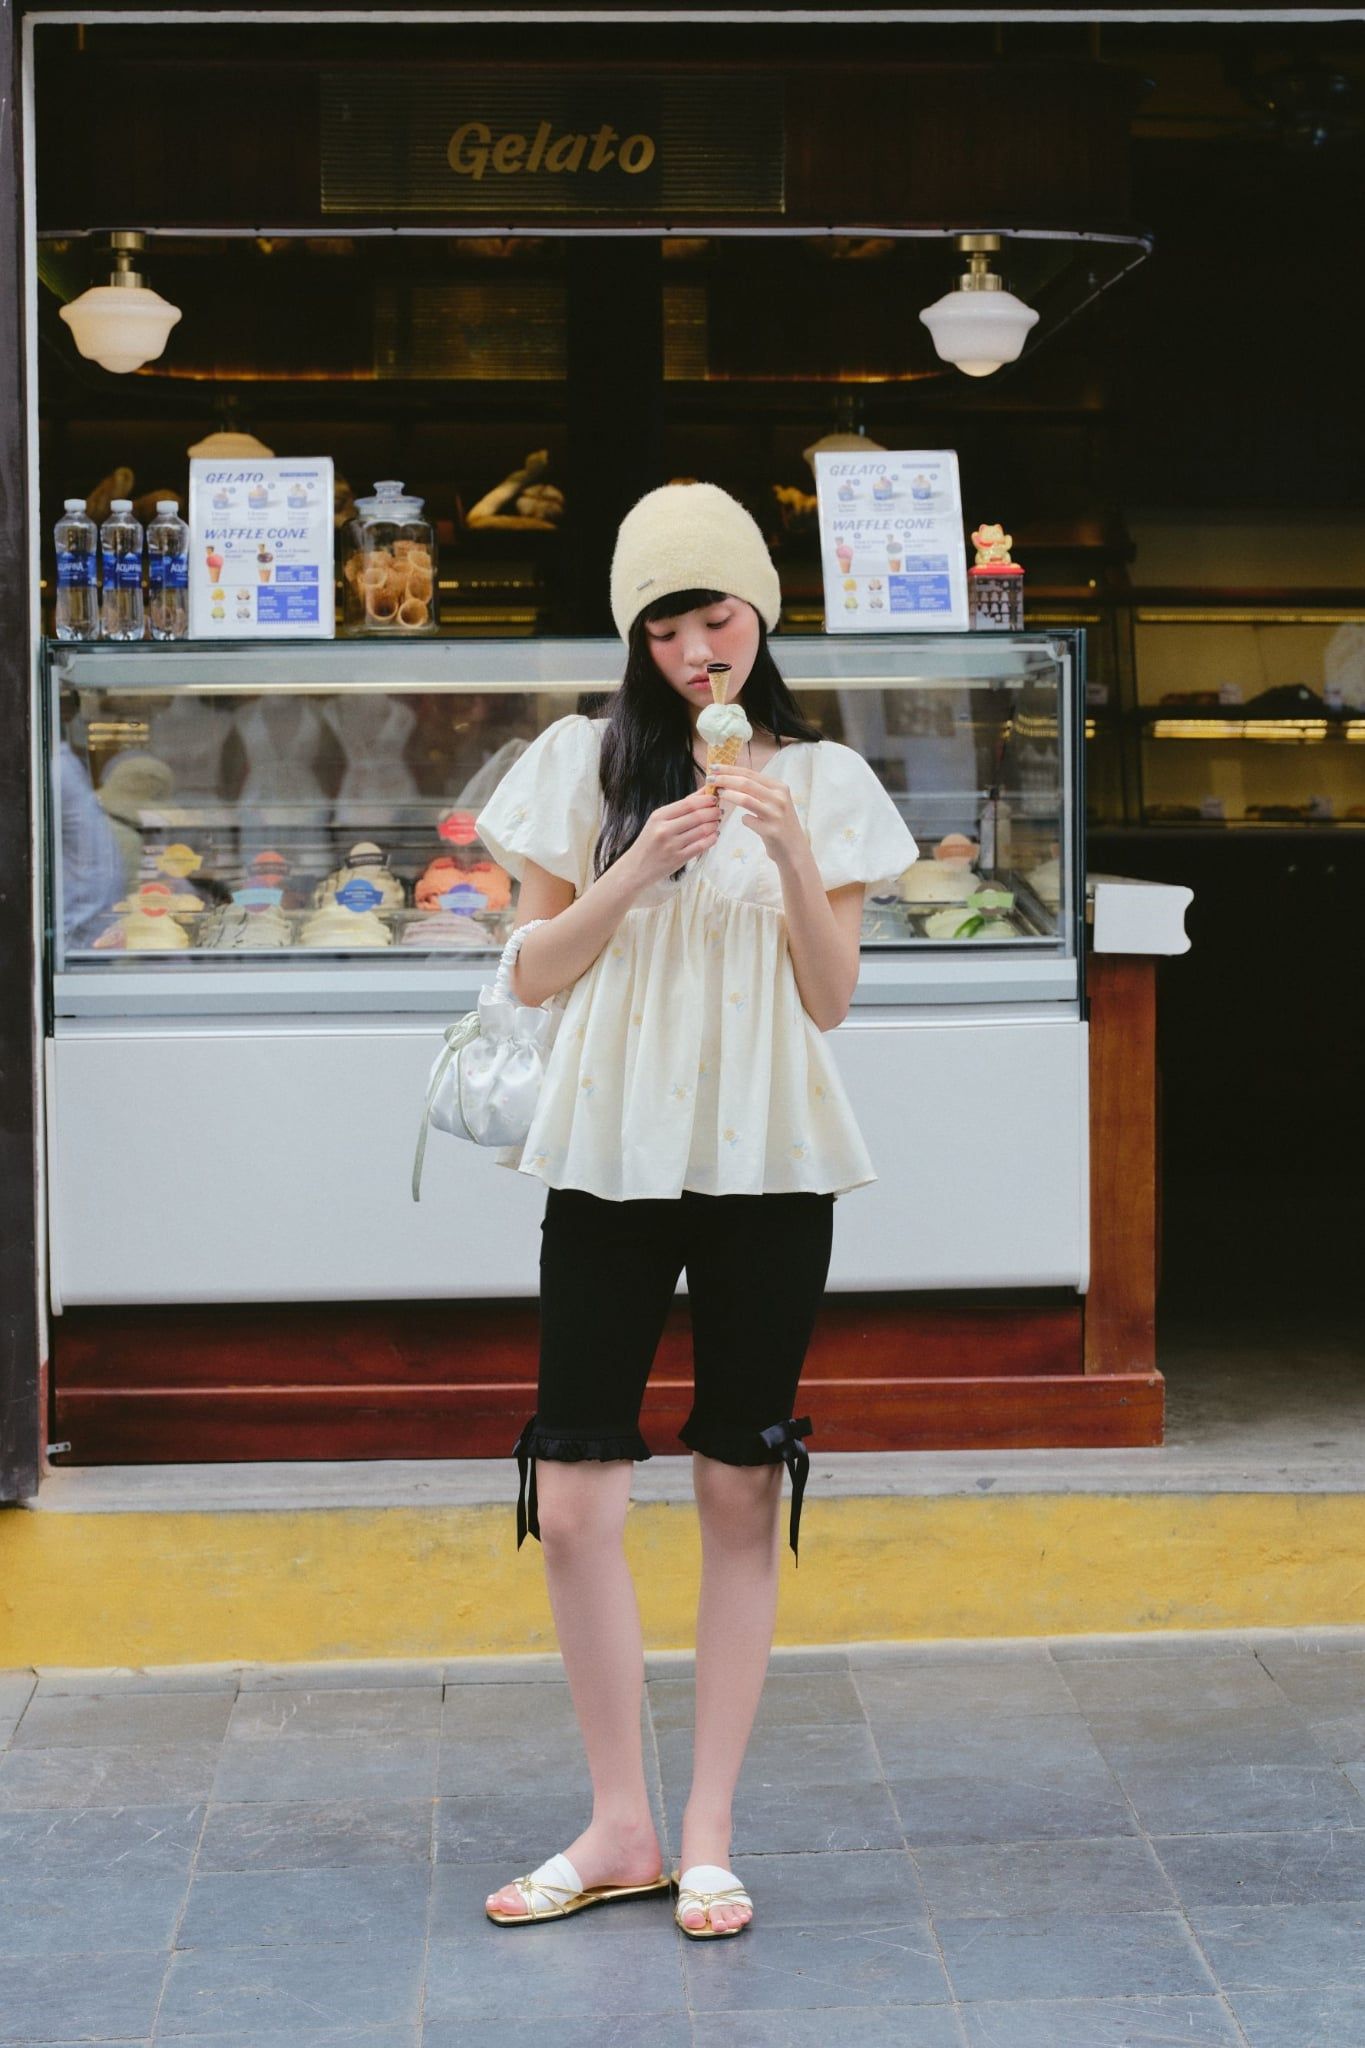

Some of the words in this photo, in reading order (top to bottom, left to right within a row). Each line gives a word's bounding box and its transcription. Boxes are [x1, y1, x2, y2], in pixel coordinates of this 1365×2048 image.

[447, 120, 655, 181] Gelato
[829, 463, 887, 476] GELATO
[205, 472, 264, 485] GELATO
[832, 519, 891, 531] WAFFLE
[894, 518, 936, 529] CONE
[204, 528, 264, 540] WAFFLE
[267, 527, 309, 539] CONE
